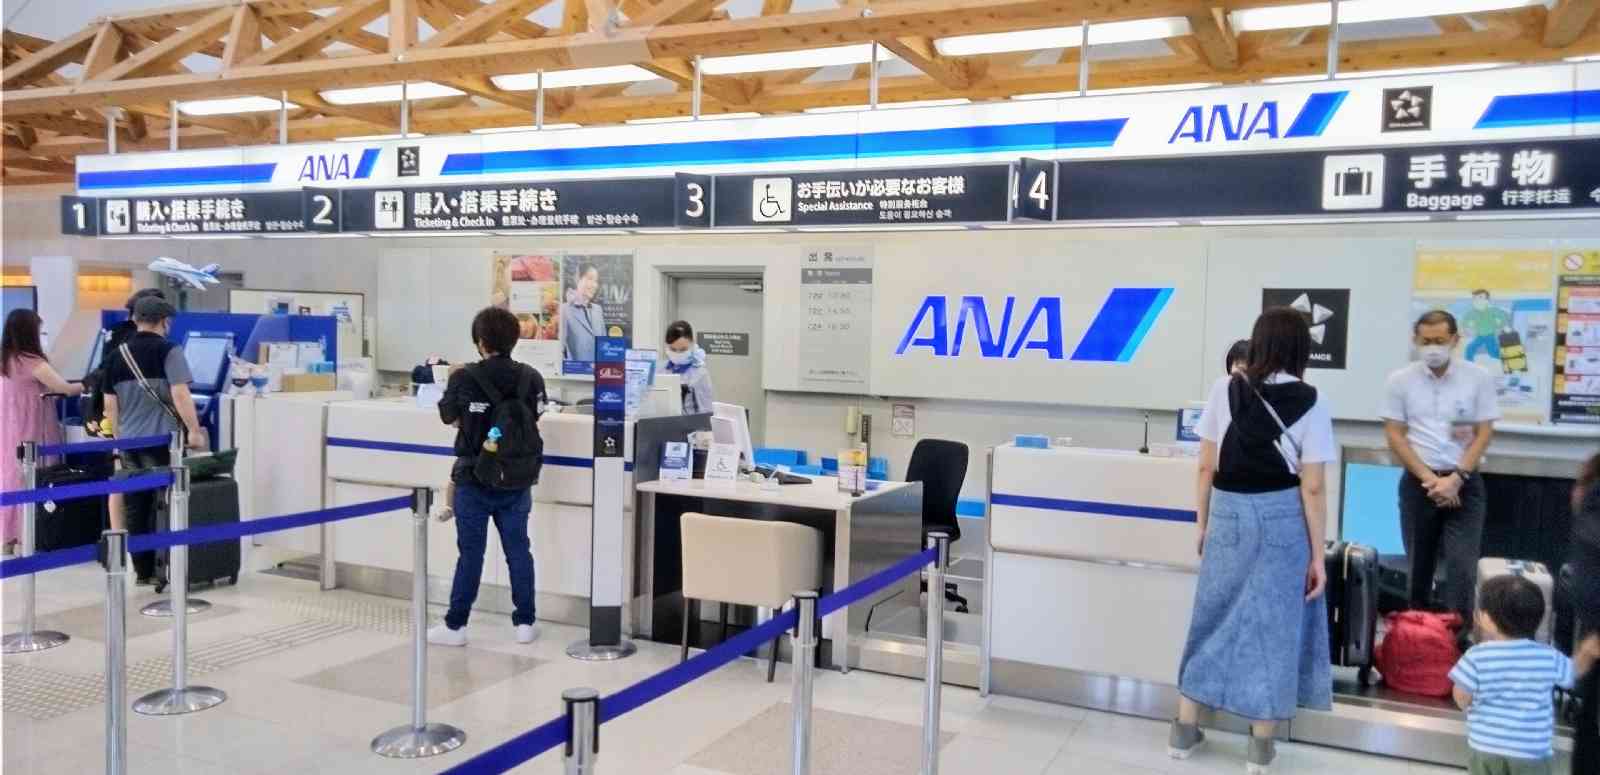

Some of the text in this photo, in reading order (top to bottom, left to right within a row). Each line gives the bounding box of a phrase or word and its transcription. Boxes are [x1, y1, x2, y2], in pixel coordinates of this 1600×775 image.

[1168, 100, 1279, 144] ANA
[298, 154, 349, 181] ANA
[1407, 150, 1556, 189] 手荷物
[685, 184, 704, 217] 3
[797, 176, 965, 198] お手伝いが必要なお客様
[1028, 170, 1050, 210] 4
[312, 194, 334, 225] 2
[414, 189, 557, 216] 購入・搭乗手続き
[797, 200, 874, 213] Special Assistance
[1406, 193, 1486, 210] Baggage
[72, 203, 85, 230] 1
[414, 217, 451, 230] Ticketing
[459, 216, 485, 227] Check
[894, 295, 1064, 360] ANA
